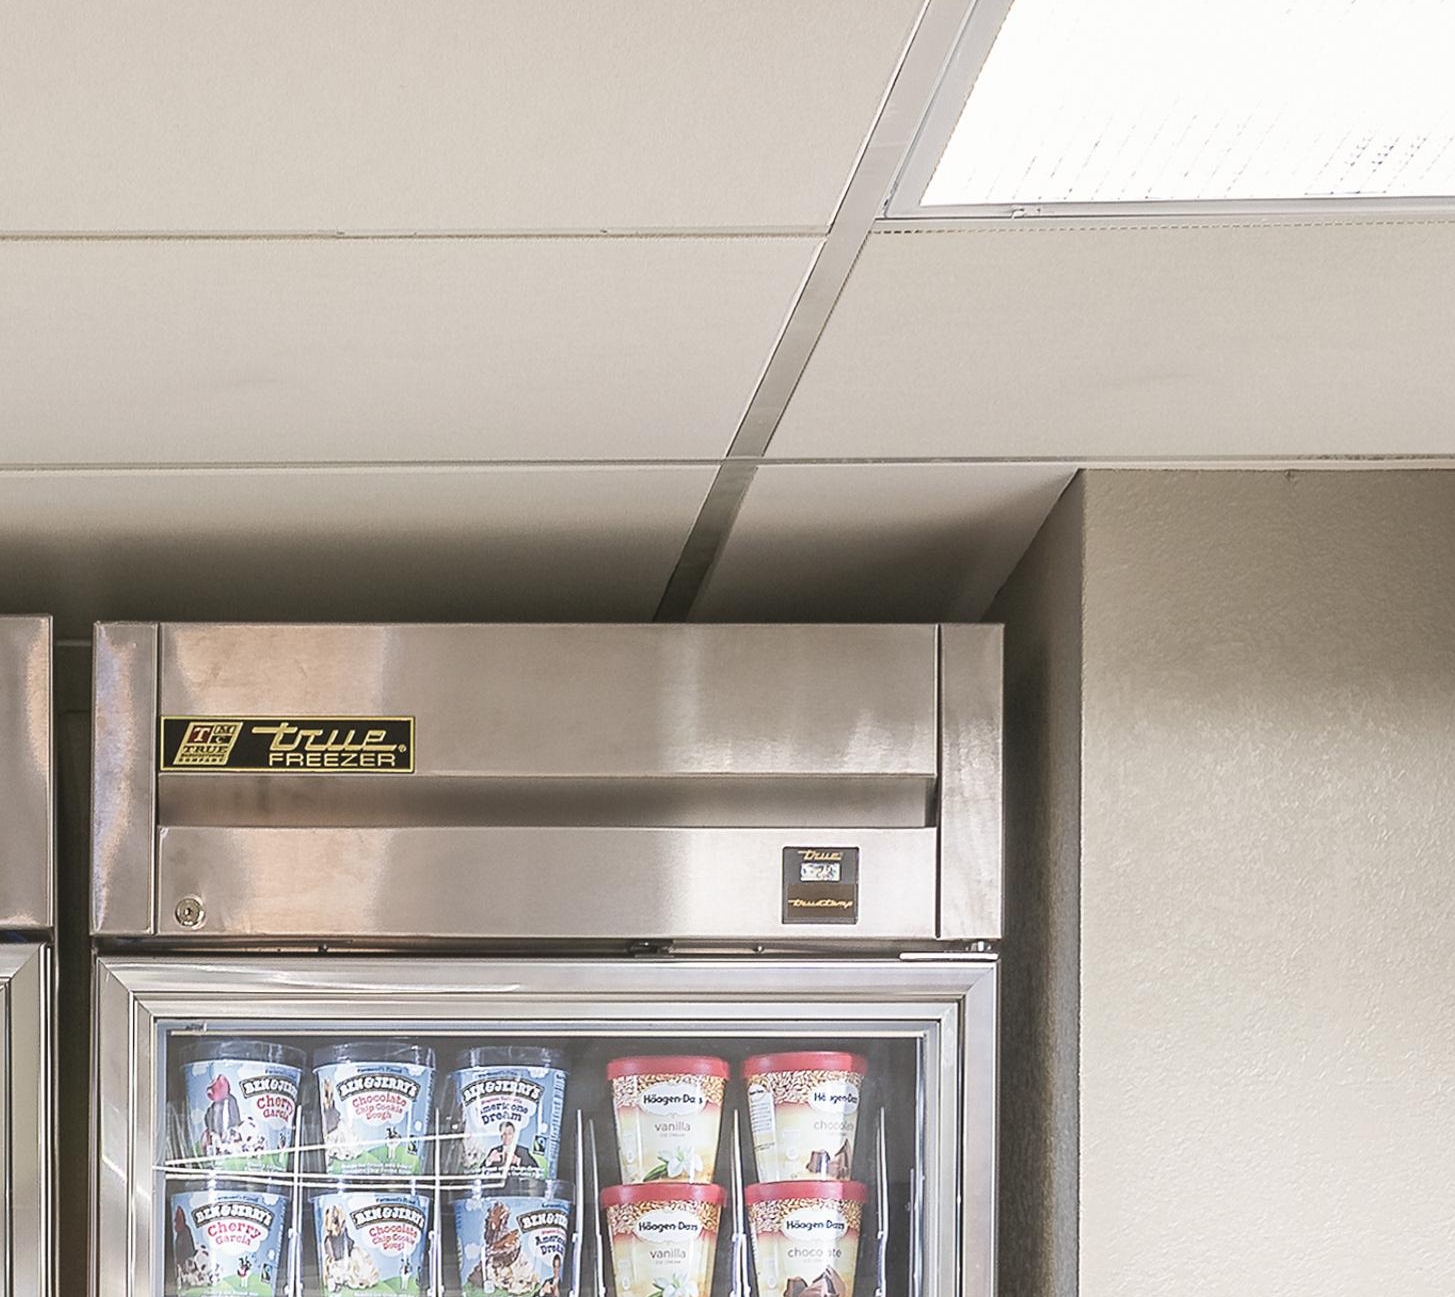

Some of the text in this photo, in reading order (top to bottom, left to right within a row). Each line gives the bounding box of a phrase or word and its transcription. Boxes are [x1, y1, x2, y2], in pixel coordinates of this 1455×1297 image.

[252, 722, 397, 751] true
[269, 753, 396, 767] FREEZER
[353, 1095, 407, 1108] Chocolate
[654, 1121, 691, 1133] vanilla
[207, 1223, 261, 1239] Cherry
[369, 1225, 419, 1238] Chocolate
[215, 1234, 252, 1247] Garcia
[650, 1248, 686, 1261] vanilla
